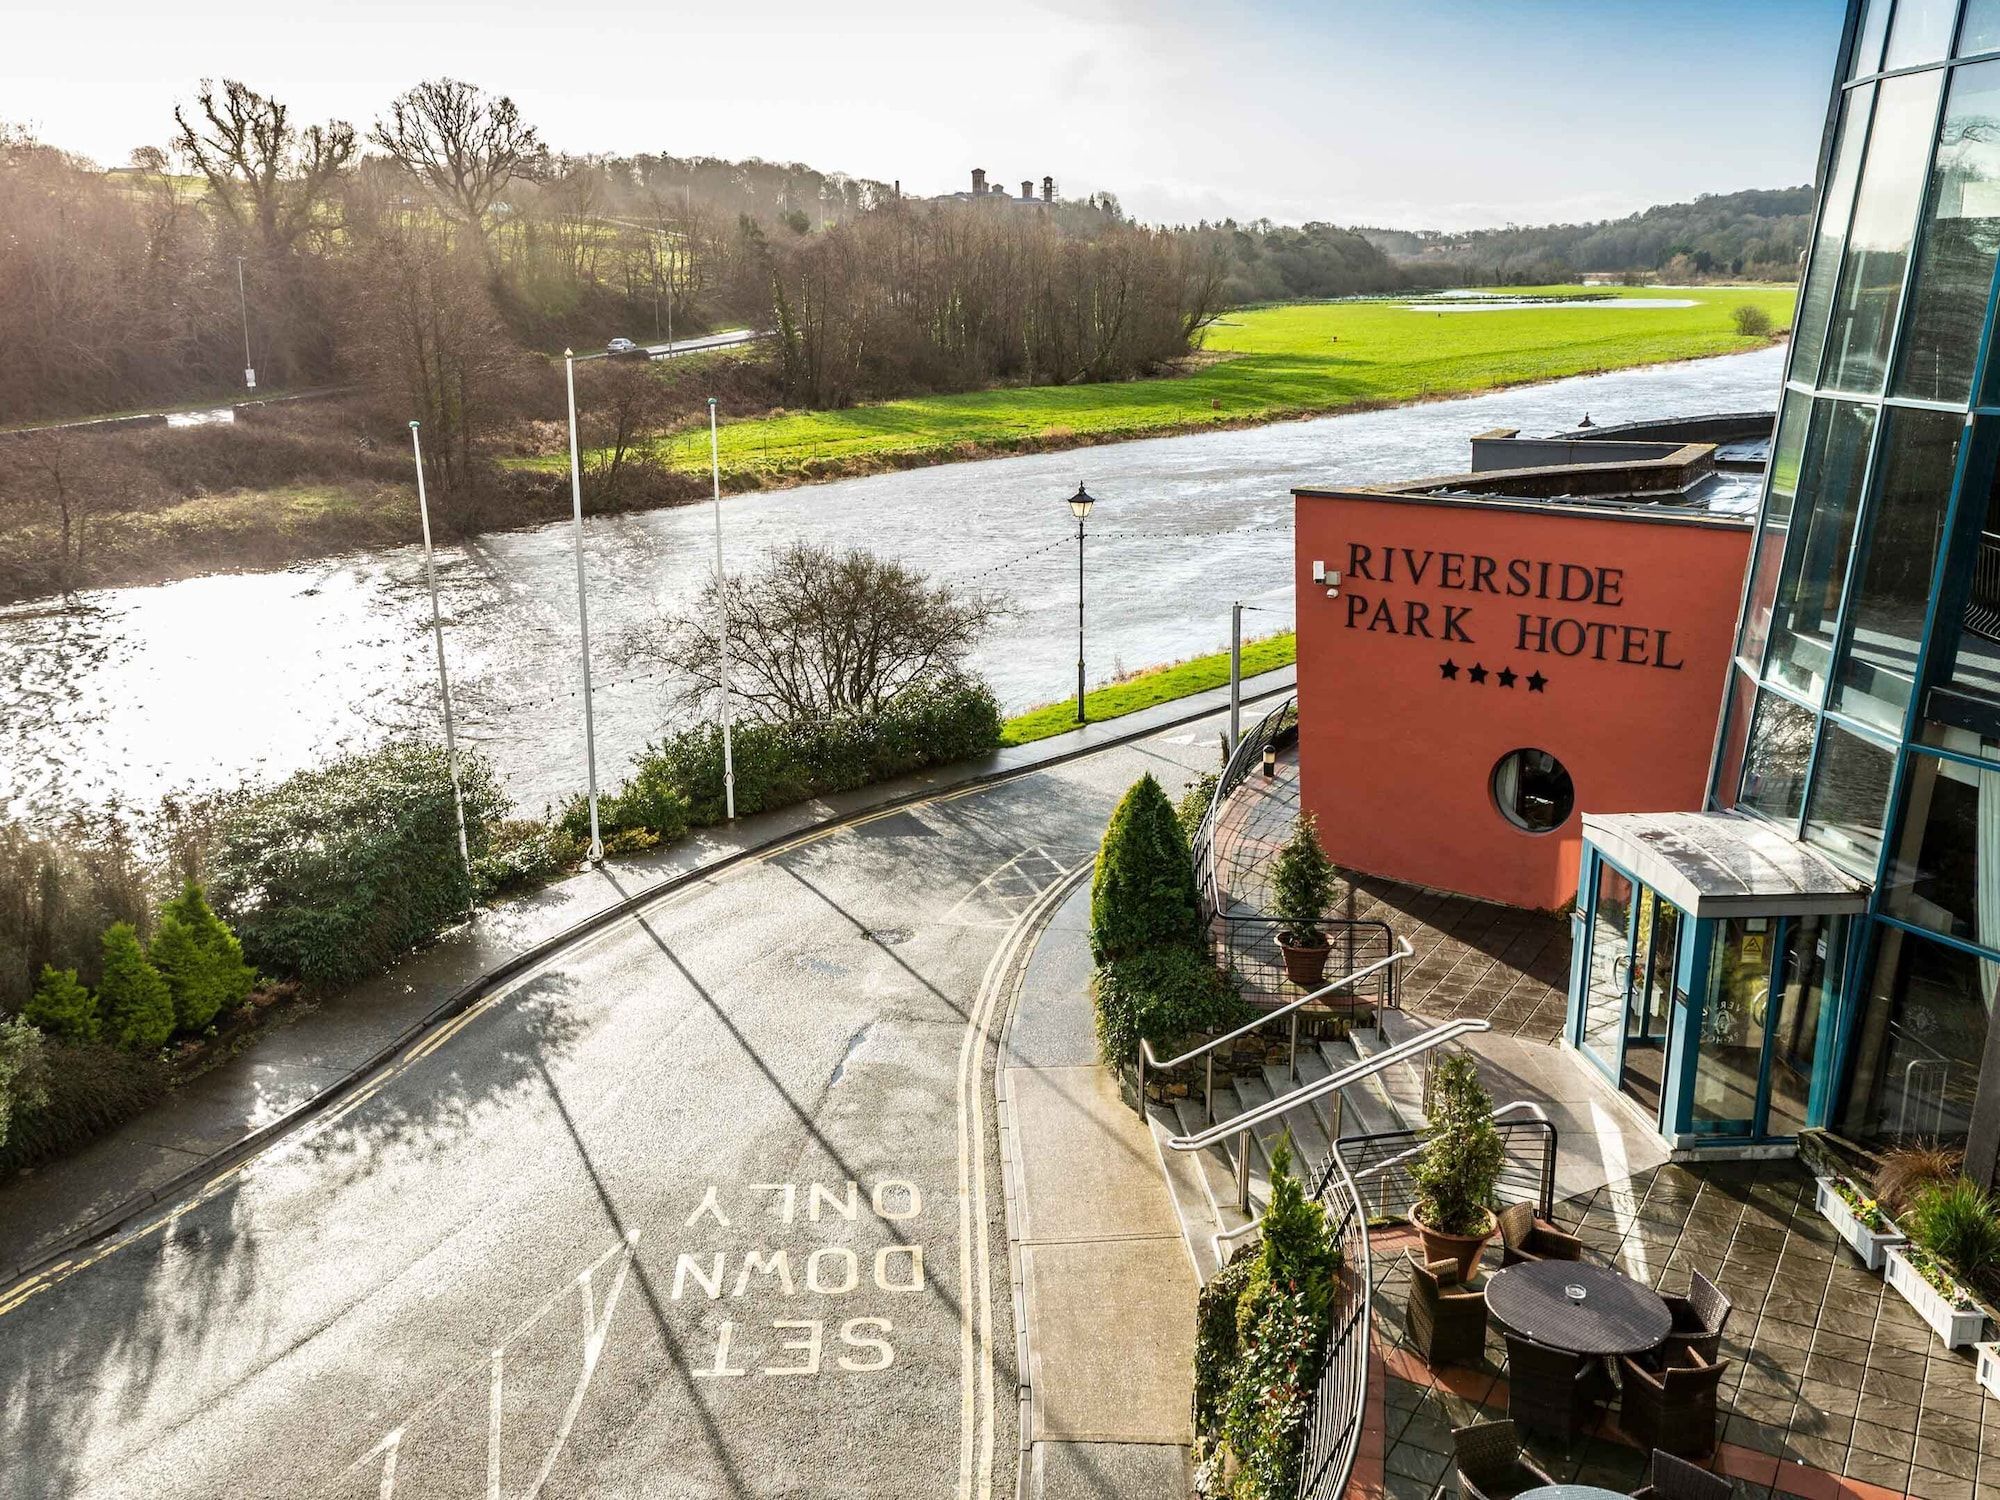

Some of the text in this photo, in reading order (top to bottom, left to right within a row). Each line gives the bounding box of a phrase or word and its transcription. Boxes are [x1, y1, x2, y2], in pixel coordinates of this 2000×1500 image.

[1346, 543, 1624, 607] RIVERSIDE
[1344, 594, 1685, 670] PARK HOTEL
[684, 1179, 922, 1226] ONLY
[670, 1245, 925, 1299] DOWN
[691, 1317, 895, 1377] SET
